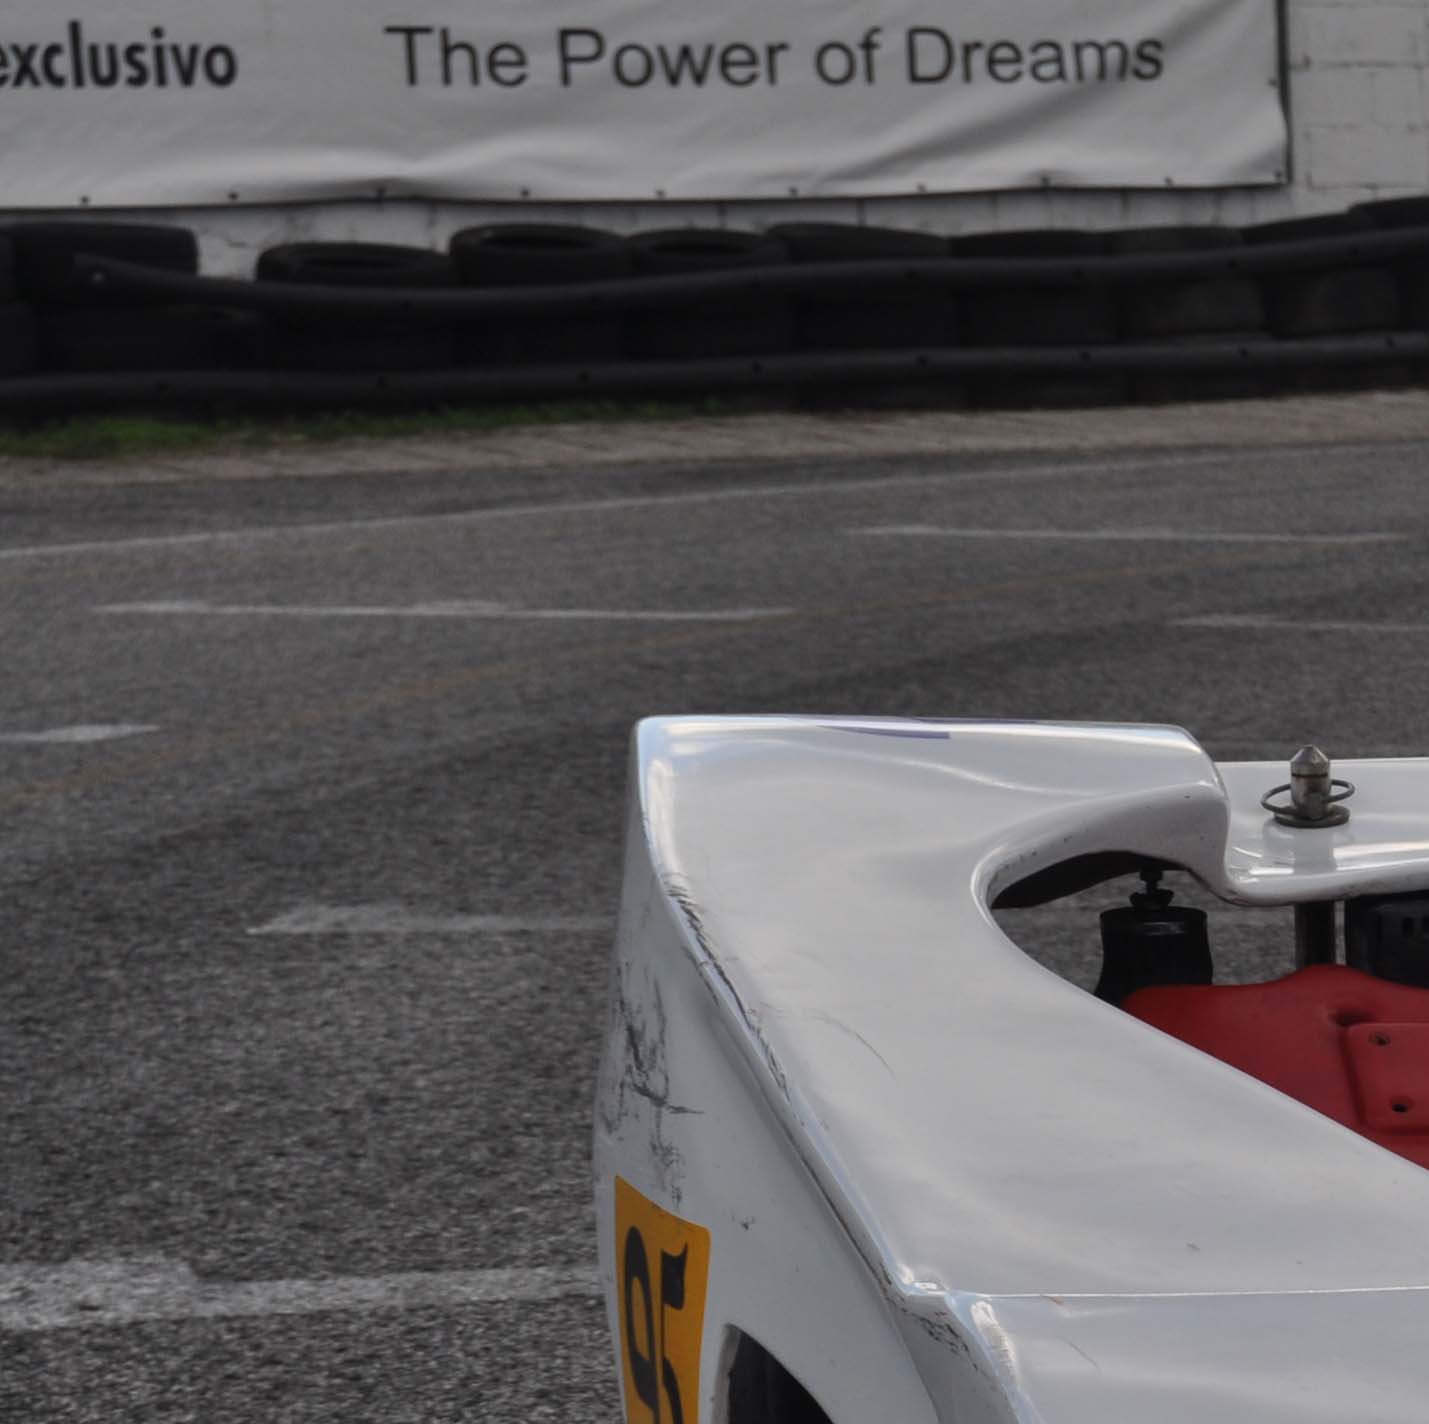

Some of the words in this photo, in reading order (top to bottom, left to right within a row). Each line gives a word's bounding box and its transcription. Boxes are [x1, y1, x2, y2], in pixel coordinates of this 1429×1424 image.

[384, 25, 529, 88] The
[556, 28, 789, 88] Power
[815, 27, 882, 86] of
[906, 26, 1165, 84] Dreams
